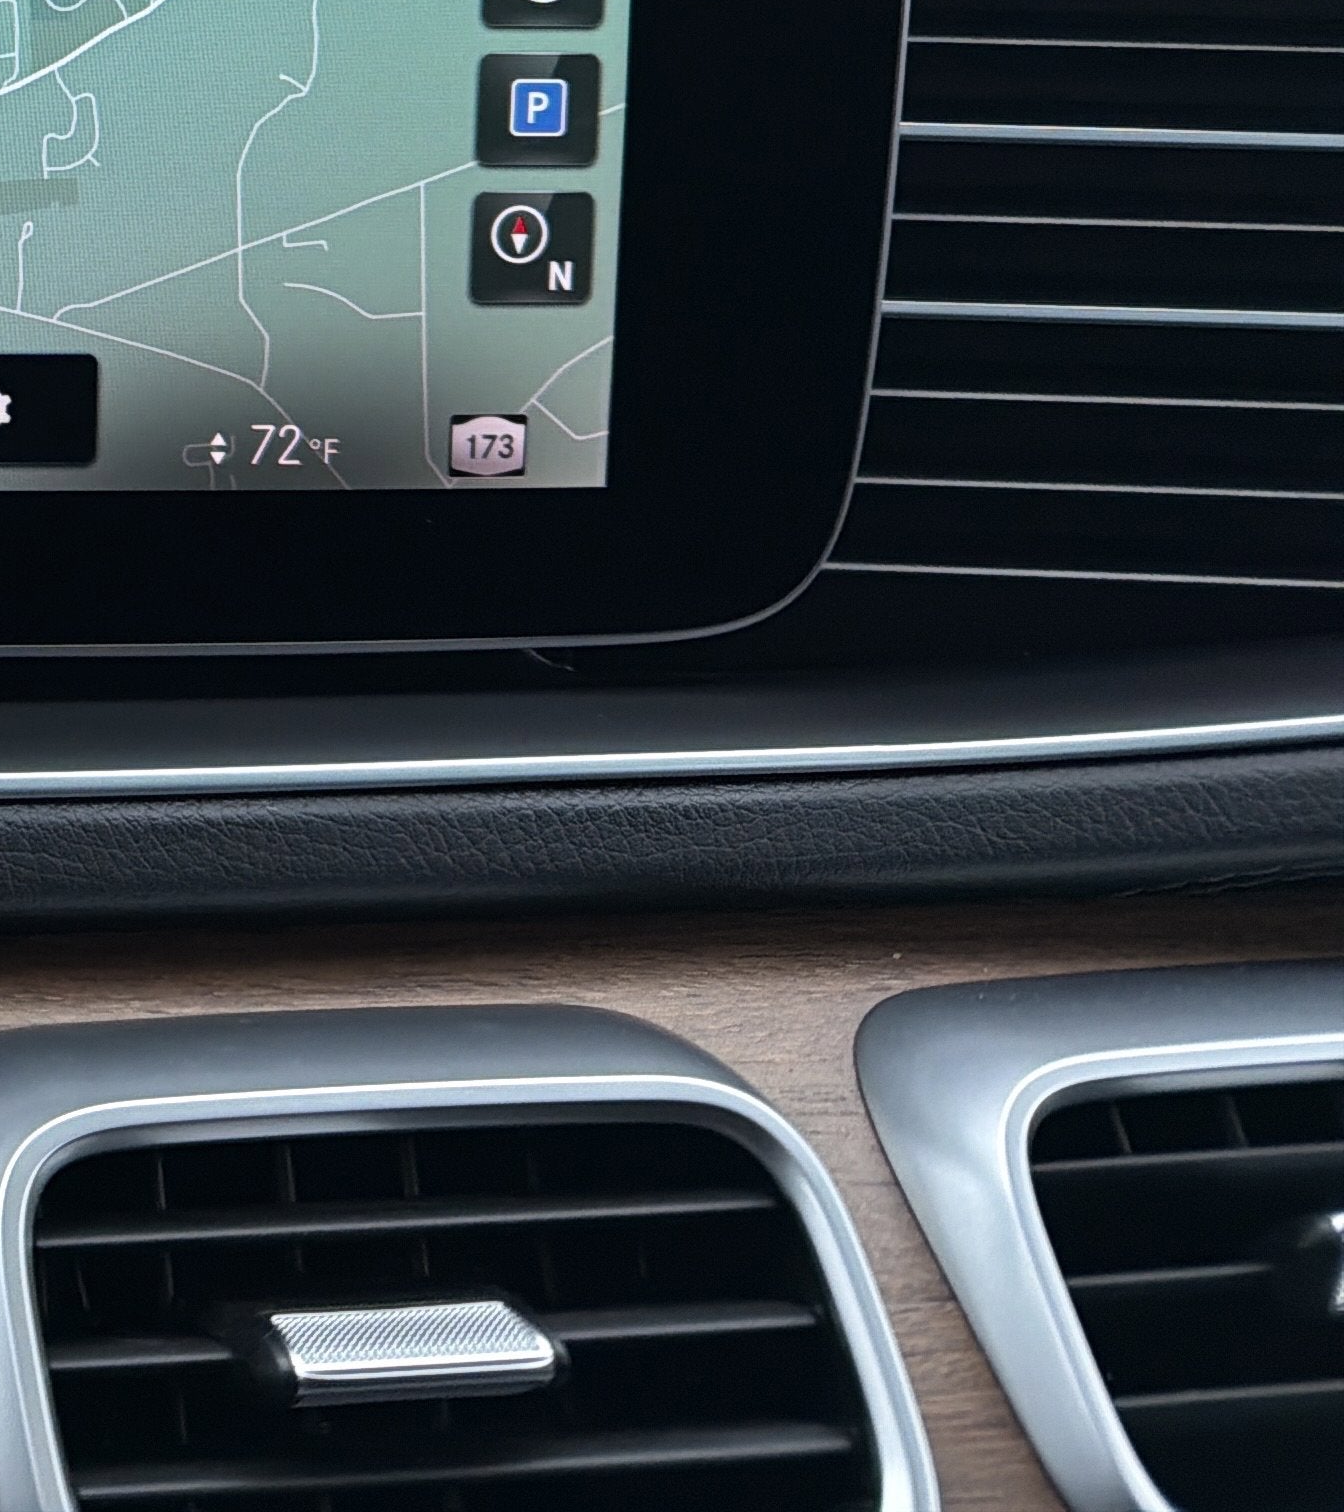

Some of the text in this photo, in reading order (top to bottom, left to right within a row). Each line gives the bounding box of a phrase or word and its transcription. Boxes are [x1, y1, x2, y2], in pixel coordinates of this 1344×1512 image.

[528, 91, 550, 125] P
[548, 261, 573, 291] N
[466, 433, 515, 459] 173
